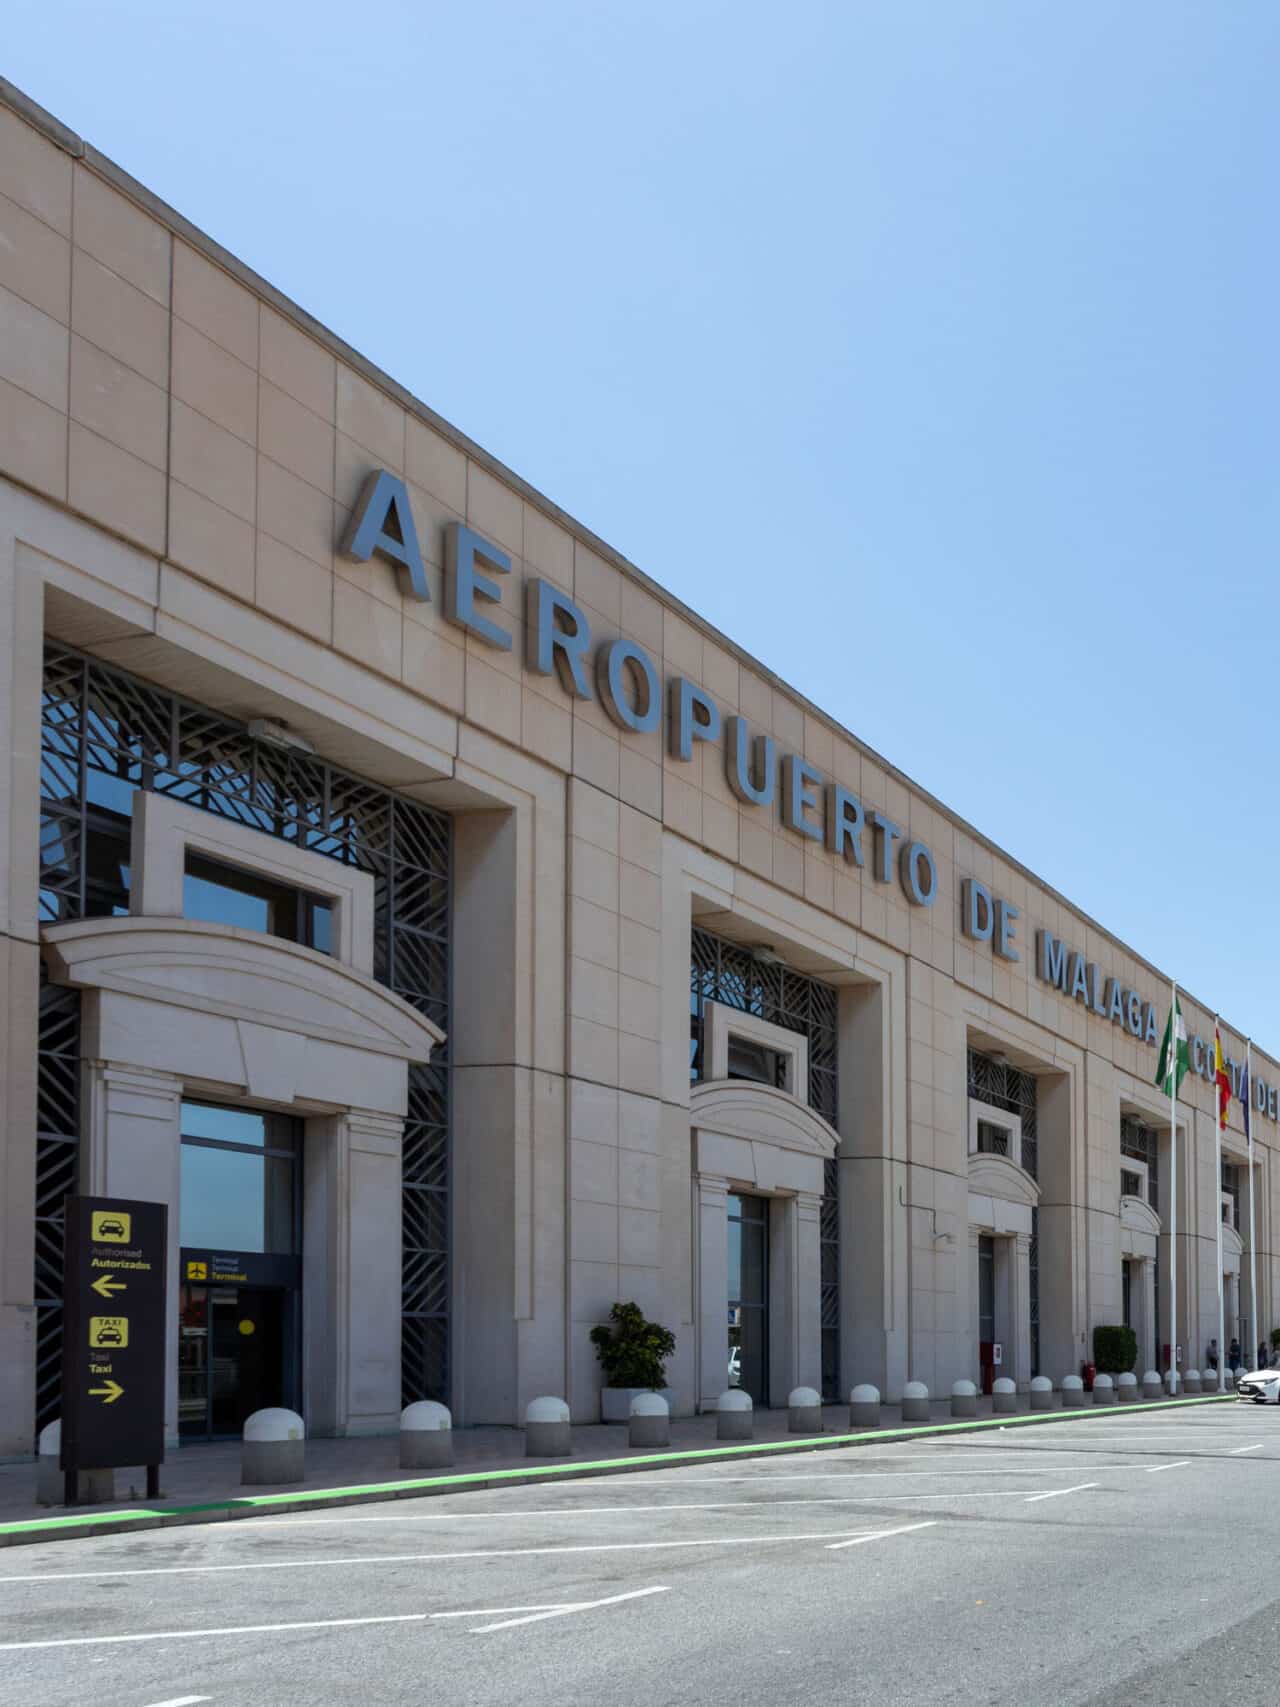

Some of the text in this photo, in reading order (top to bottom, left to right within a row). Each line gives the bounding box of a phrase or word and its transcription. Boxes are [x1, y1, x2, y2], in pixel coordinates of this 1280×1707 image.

[342, 468, 938, 908] AEROPUERTO
[964, 879, 1019, 962] DE
[1036, 930, 1159, 1048] MALAGA
[1252, 1077, 1280, 1121] DEL
[91, 1258, 151, 1270] Autorizados
[89, 1364, 112, 1374] Taxi
